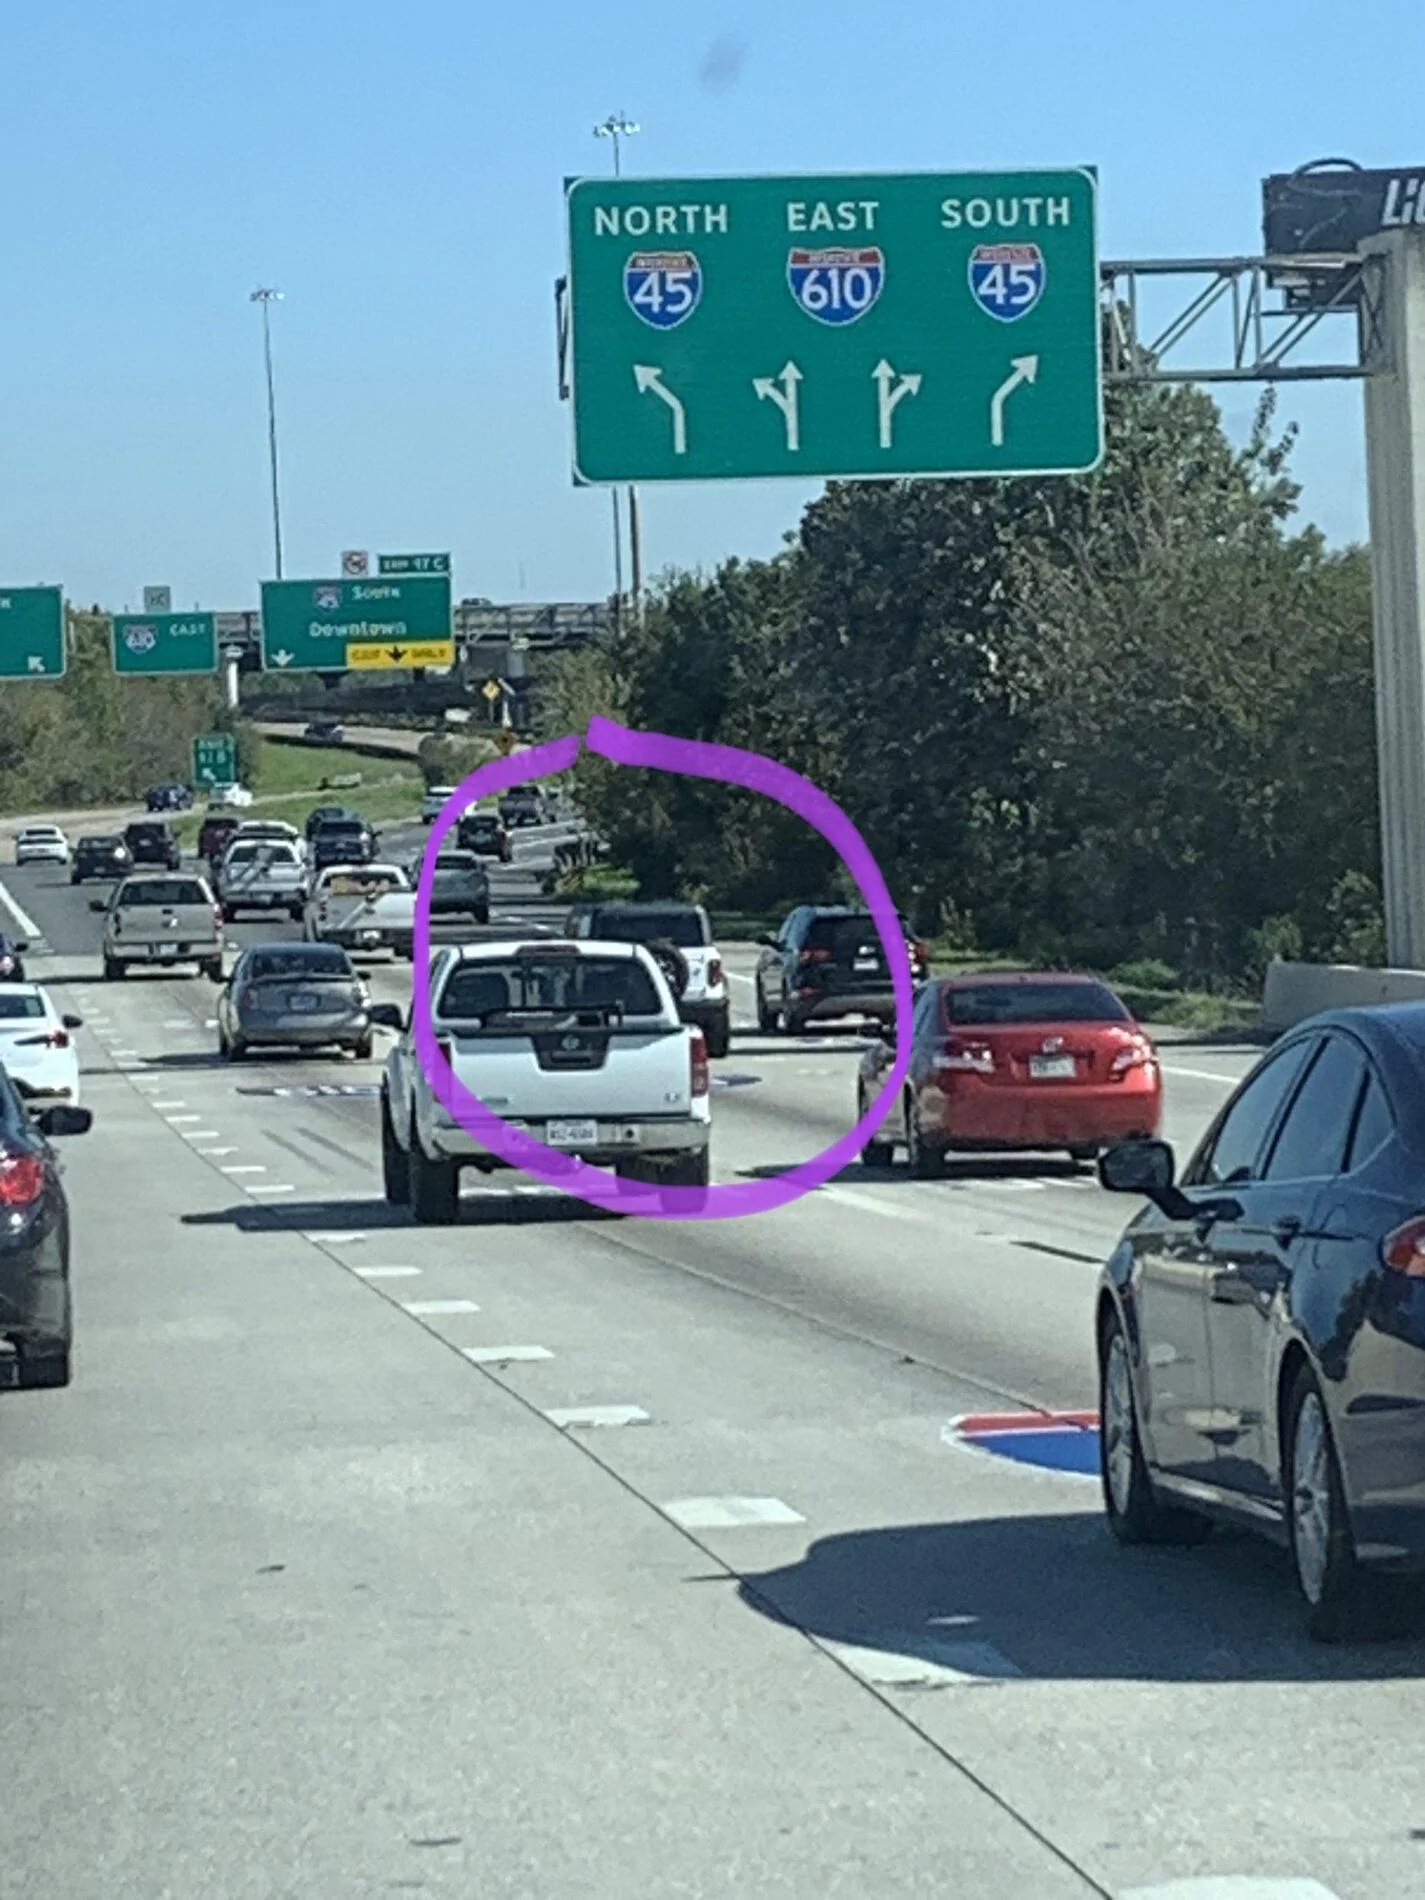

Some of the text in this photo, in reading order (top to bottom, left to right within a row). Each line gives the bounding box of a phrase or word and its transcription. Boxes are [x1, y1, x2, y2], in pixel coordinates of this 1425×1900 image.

[594, 204, 728, 236] NORTH
[786, 201, 880, 232] EAST
[940, 197, 1071, 228] SOUTH
[633, 269, 693, 314] 45
[801, 266, 872, 311] 610
[977, 263, 1037, 305] 45
[308, 620, 407, 637] Downtown
